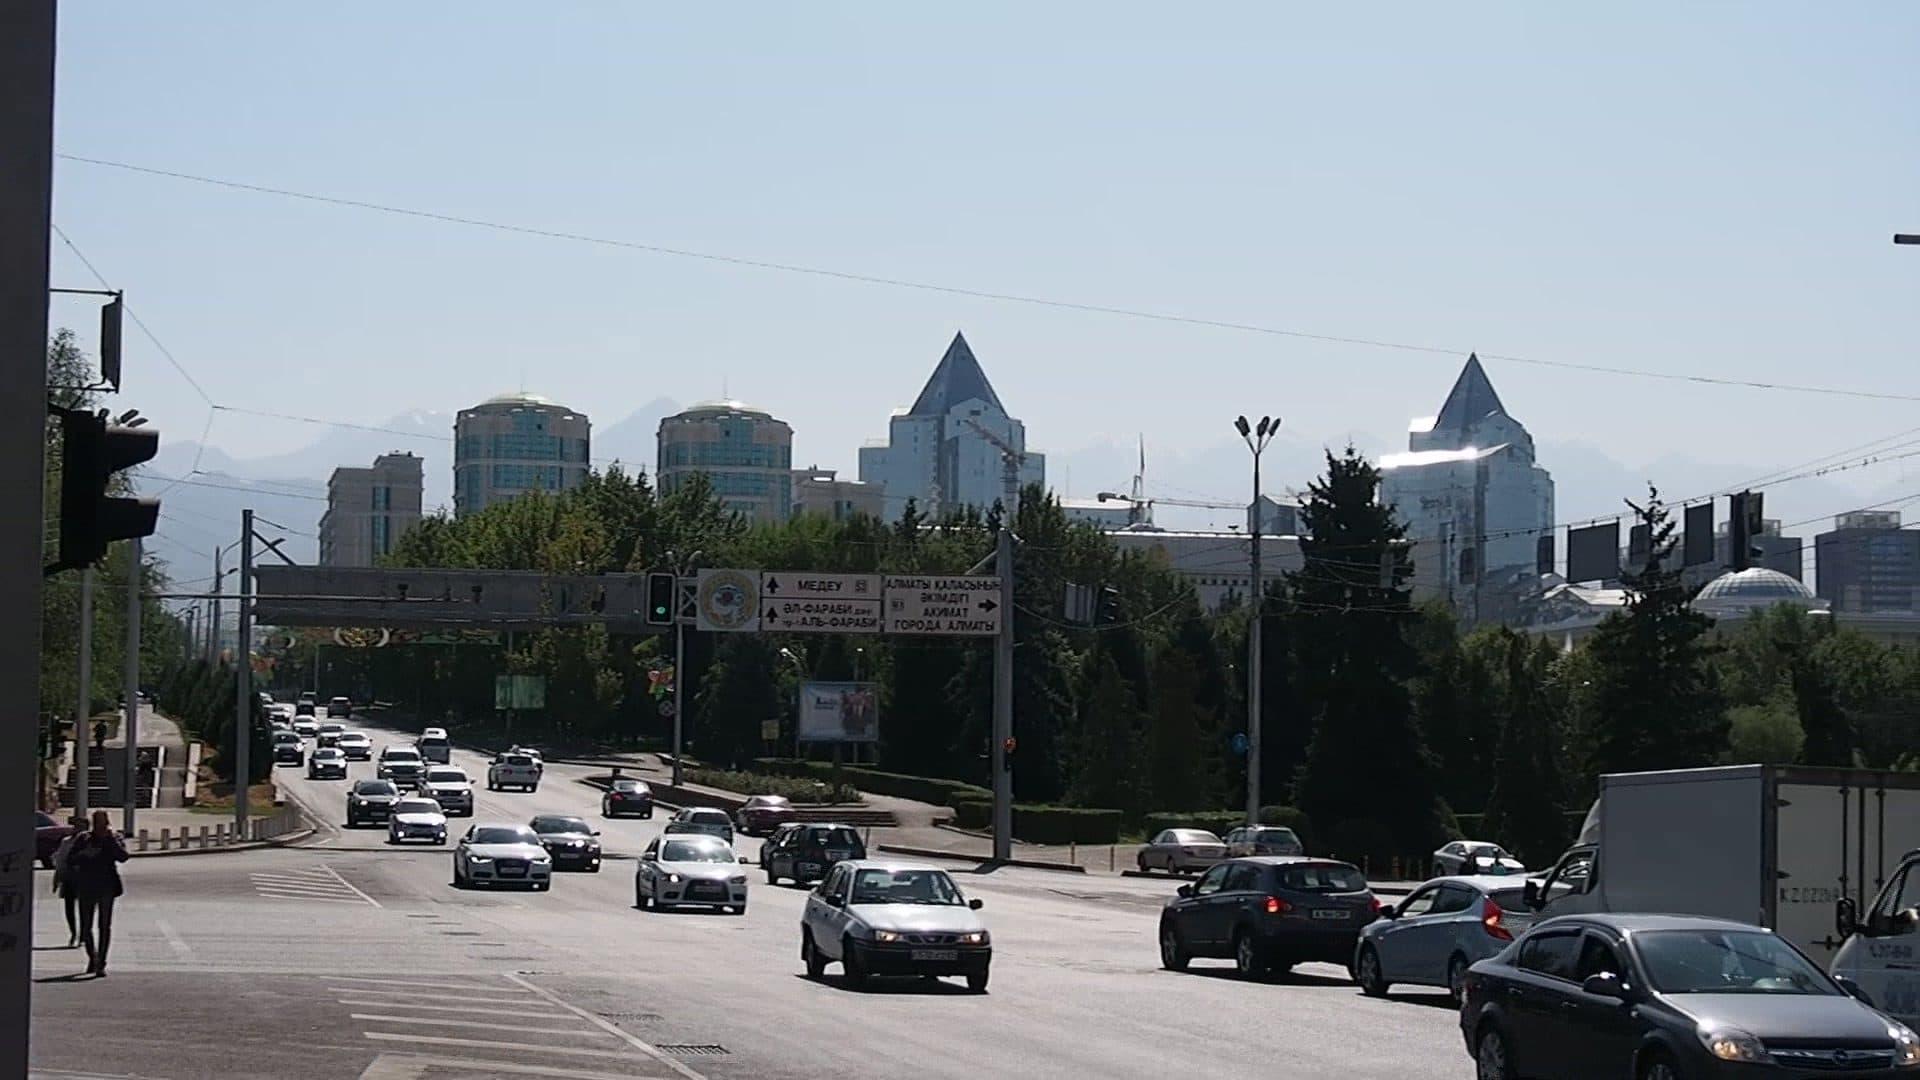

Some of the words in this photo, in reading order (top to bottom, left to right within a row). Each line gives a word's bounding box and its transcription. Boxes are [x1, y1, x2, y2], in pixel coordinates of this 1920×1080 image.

[798, 580, 843, 592] МЕДЕУ
[885, 578, 930, 589] АЛМАТЫ
[783, 603, 852, 614] ӘЛ-ФАРАБИ
[923, 607, 969, 618] АКИМАТ
[801, 617, 877, 628] АЛЬ-ФАРАБИ
[894, 619, 941, 631] ГОРОДА
[947, 620, 995, 632] АЛМАТЫ
